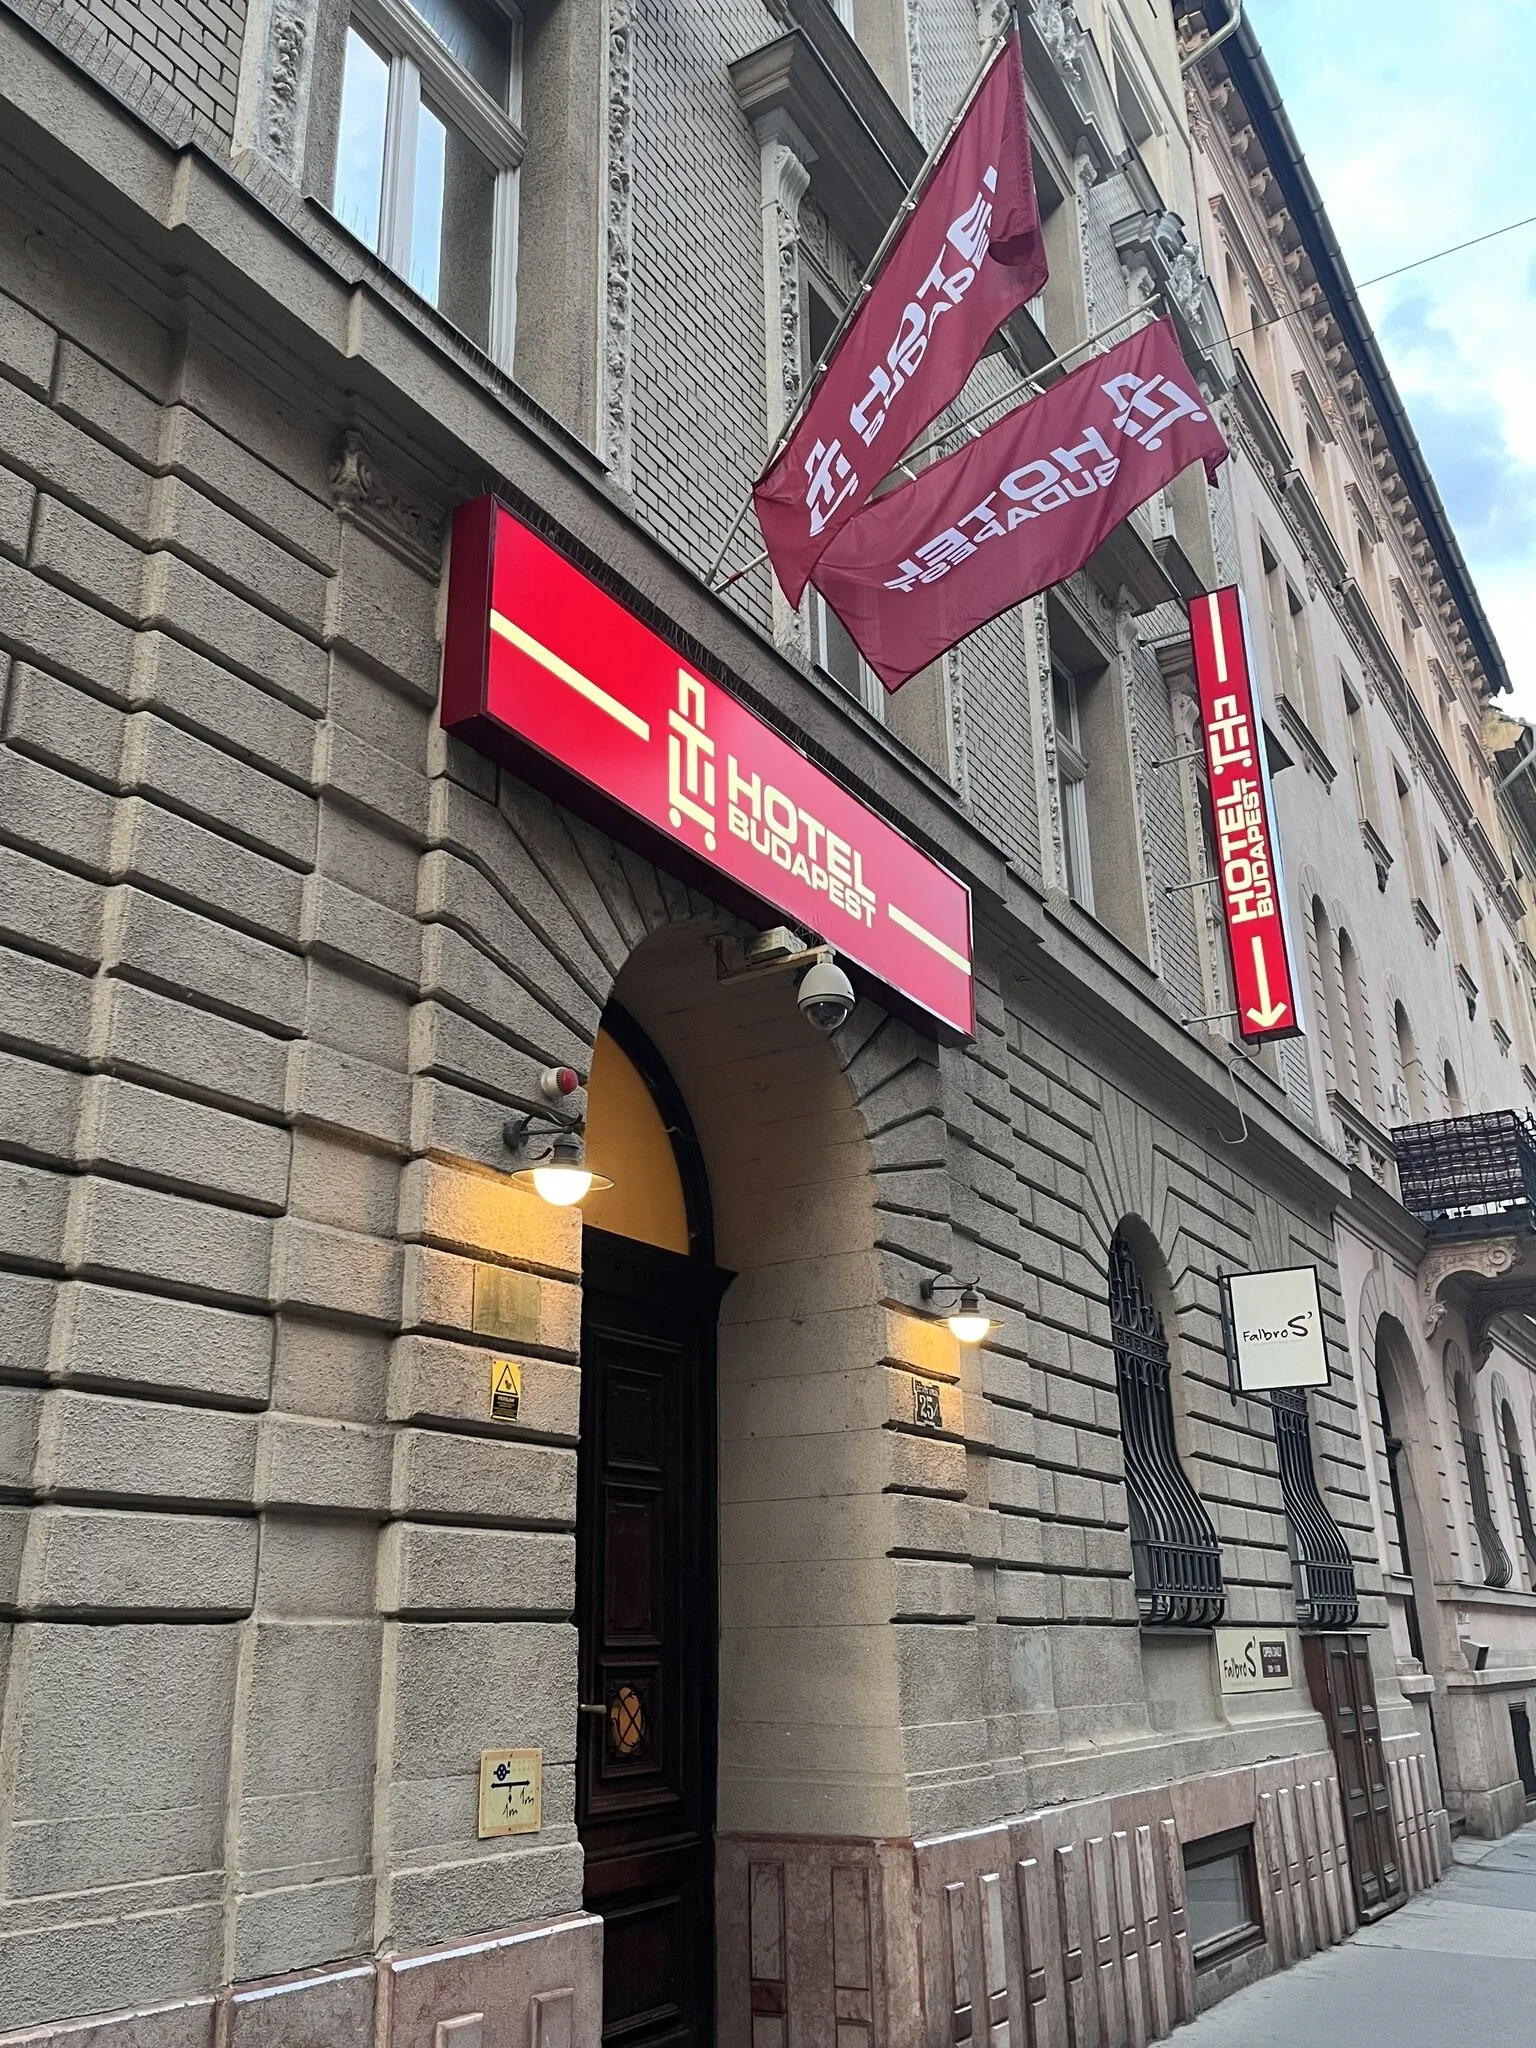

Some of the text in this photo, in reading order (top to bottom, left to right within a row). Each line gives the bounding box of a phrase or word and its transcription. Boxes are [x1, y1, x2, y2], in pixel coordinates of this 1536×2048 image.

[727, 753, 877, 905] HOTEL
[728, 801, 877, 929] BUDAPEST
[1216, 779, 1258, 924] HOTEL
[1240, 778, 1275, 918] BUDAPEST
